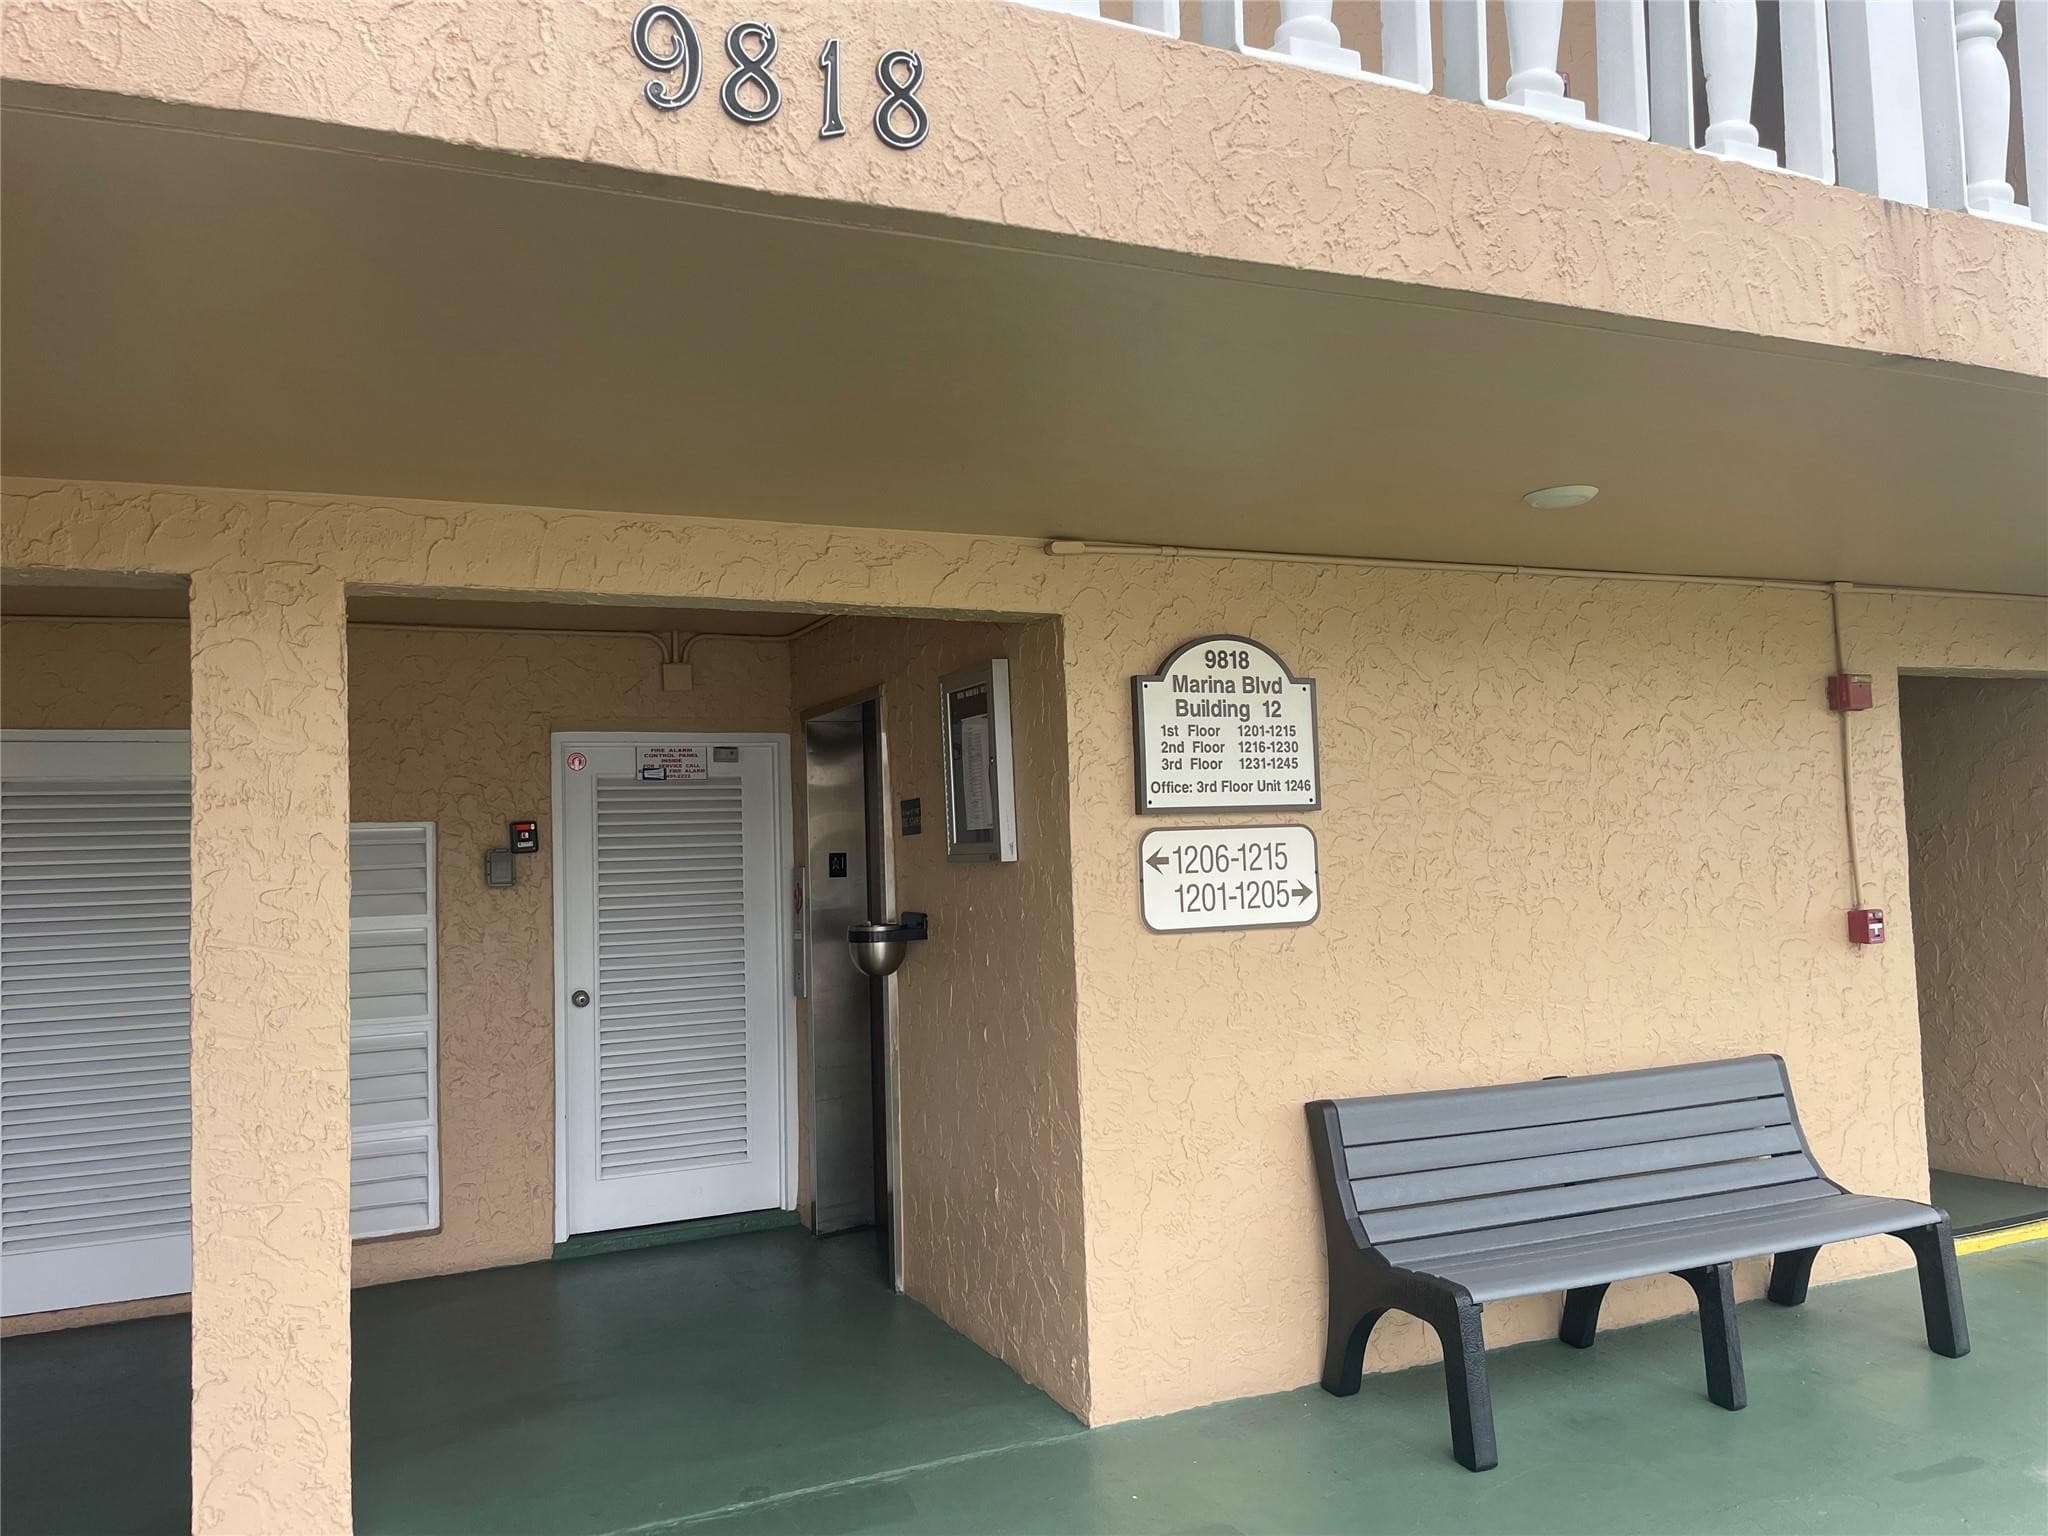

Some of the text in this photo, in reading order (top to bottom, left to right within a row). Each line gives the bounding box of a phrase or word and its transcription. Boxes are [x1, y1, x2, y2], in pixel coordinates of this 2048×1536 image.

[631, 2, 930, 150] 9818
[1204, 649, 1250, 669] 9818
[1172, 674, 1283, 694] Marina Blvd
[1175, 698, 1282, 722] Building 12
[1160, 724, 1297, 737] 1st Floor 1201-1215
[1160, 741, 1299, 754] 2nd Floor 1216-1230
[1161, 757, 1299, 770] 3rd Floor 1231-1245
[1150, 779, 1312, 794] Office: 3rd Floor Unit 1246
[1172, 842, 1289, 875] 1206-1215
[1174, 879, 1290, 913] 1201-1205
